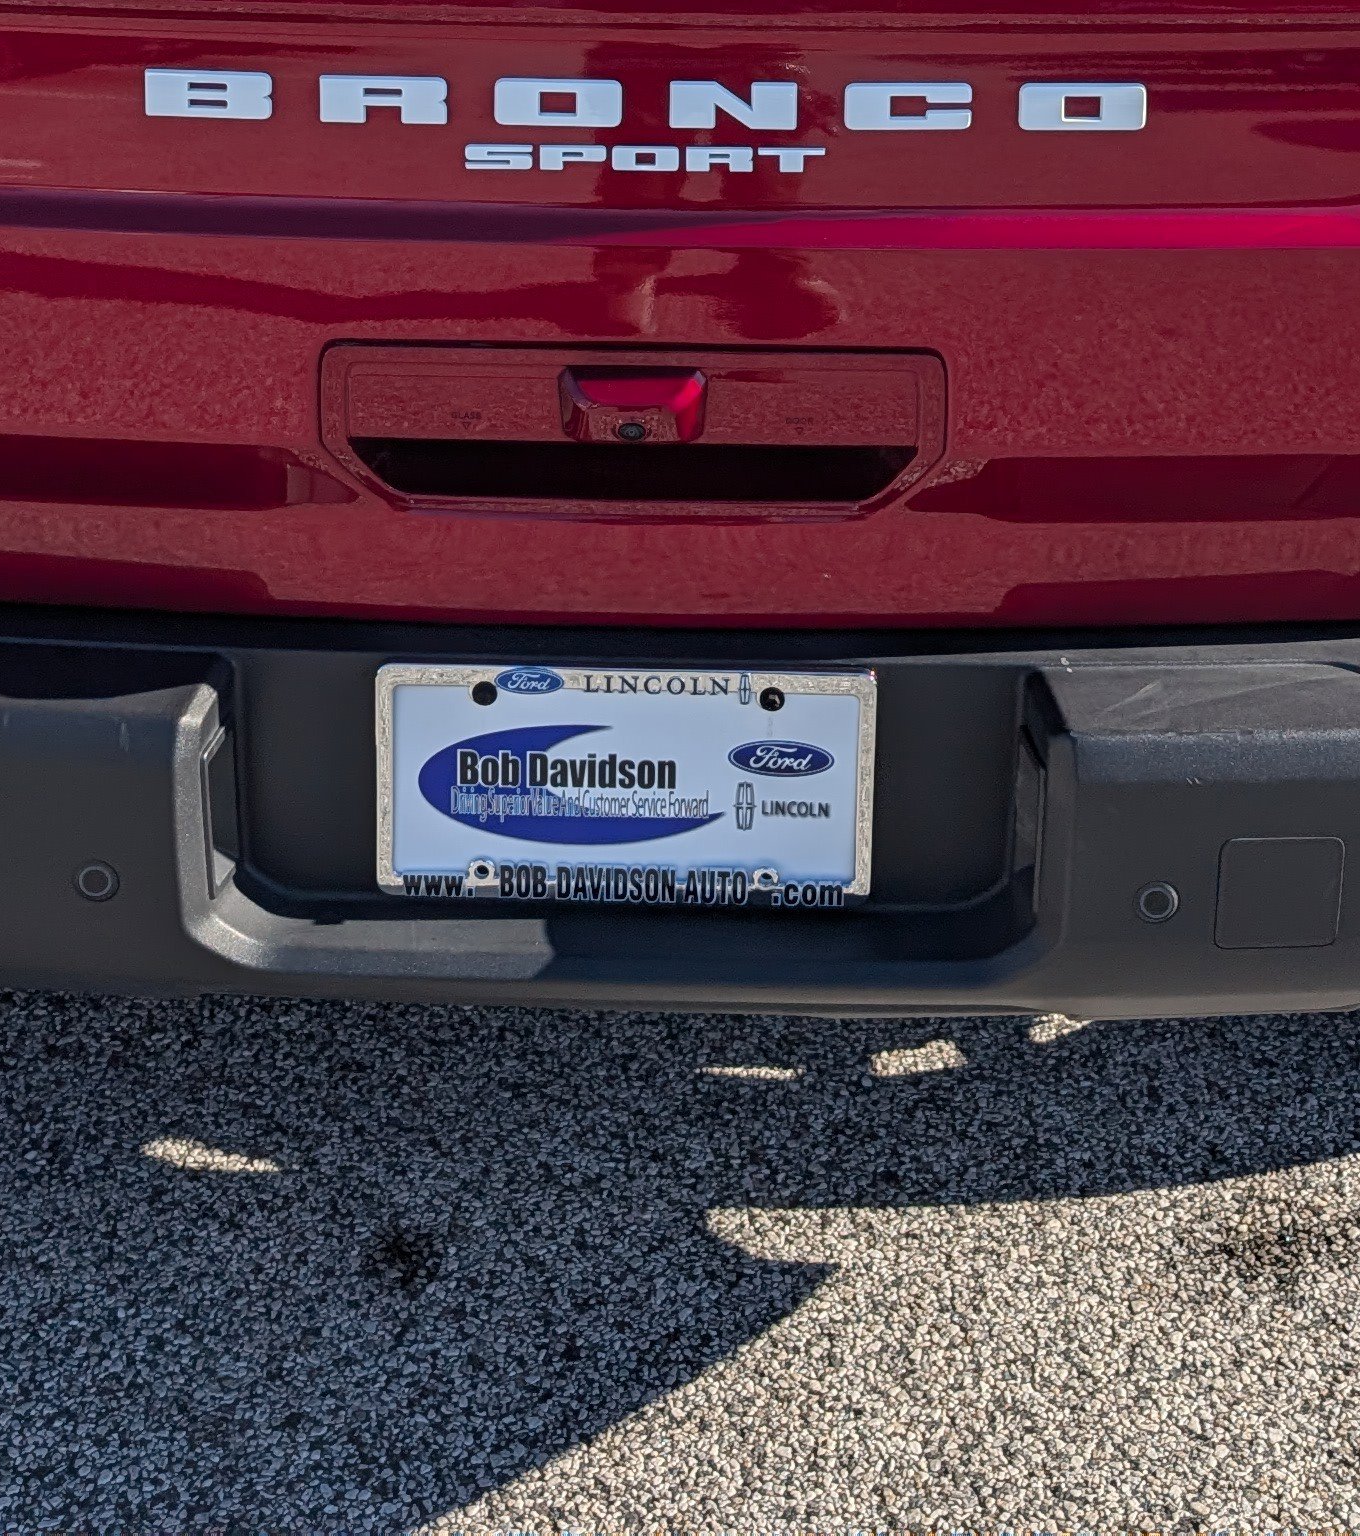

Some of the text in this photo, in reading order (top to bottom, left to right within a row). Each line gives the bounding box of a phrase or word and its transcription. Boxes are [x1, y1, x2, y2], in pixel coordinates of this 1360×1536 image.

[143, 68, 1147, 132] BRONCO
[464, 144, 826, 174] SPORT
[507, 671, 730, 695] Ford LINCOLN
[458, 749, 677, 790] Bob Davidson
[749, 745, 813, 771] Ford
[582, 790, 630, 818] Customer
[631, 791, 667, 818] Service
[668, 790, 710, 819] Forward
[761, 799, 831, 819] LINCOLN
[498, 863, 549, 899] BOB
[555, 865, 678, 904] DAVIDSON
[683, 868, 750, 906] AUTO
